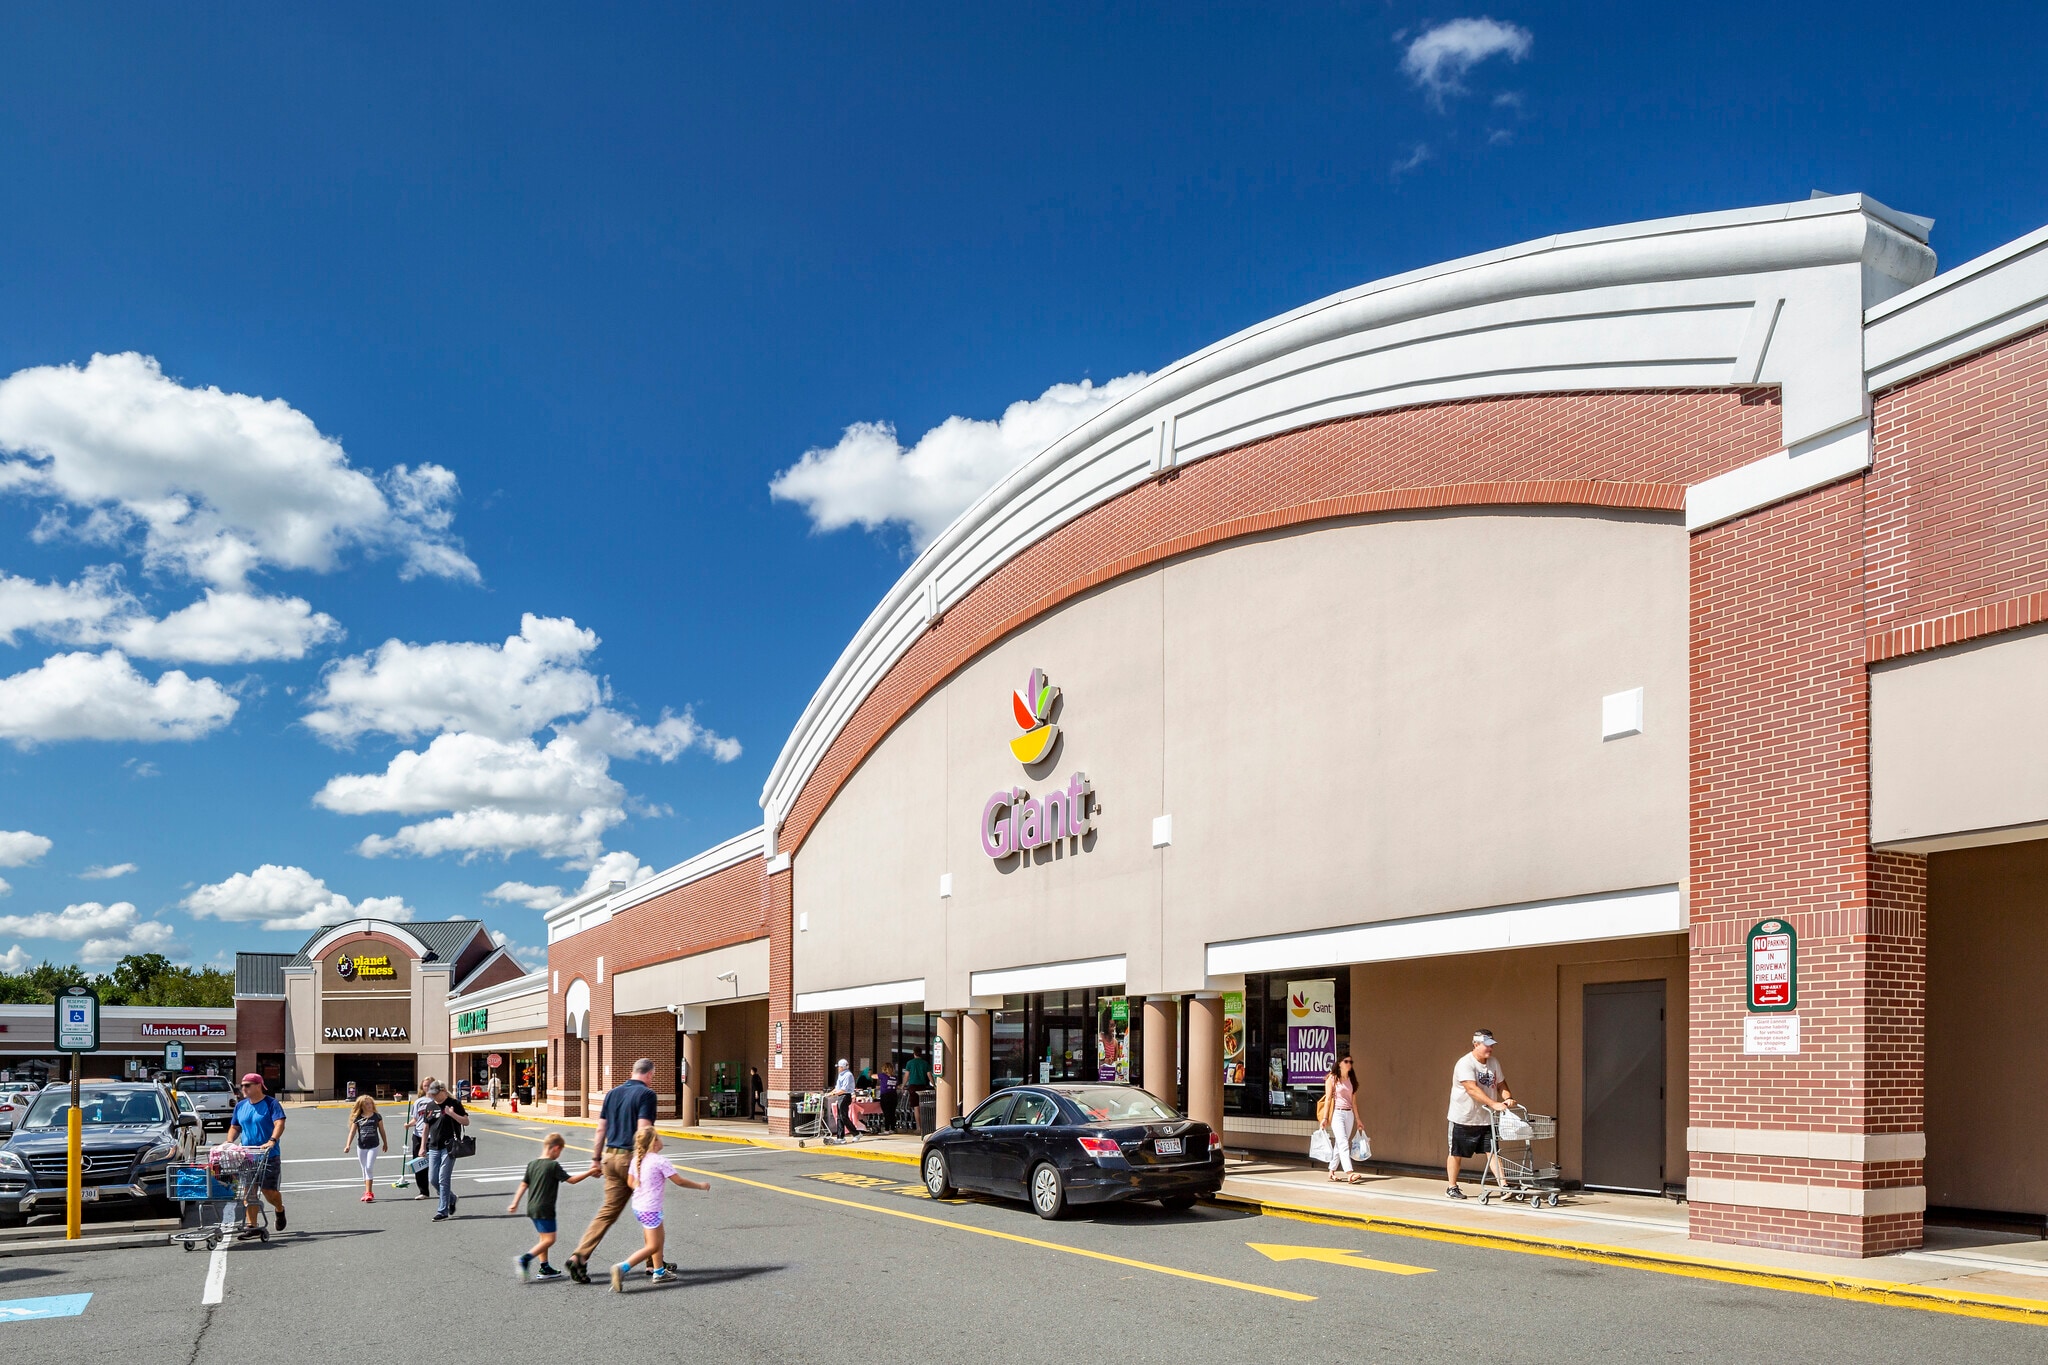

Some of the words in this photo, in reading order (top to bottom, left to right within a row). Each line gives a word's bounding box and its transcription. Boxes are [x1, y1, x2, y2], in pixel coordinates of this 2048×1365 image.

[981, 772, 1088, 859] Giant
[1755, 938, 1767, 950] NO
[1768, 939, 1787, 948] PARKING
[353, 955, 387, 968] planet
[1756, 963, 1786, 971] DRIVEWAY
[357, 965, 394, 975] fitness
[1313, 1001, 1332, 1013] Giant
[142, 1024, 197, 1036] Manhattan
[199, 1024, 225, 1036] Pizza
[324, 1027, 363, 1037] SALON
[368, 1027, 406, 1037] PLAZA
[1298, 1028, 1329, 1049] NOW
[1290, 1051, 1335, 1072] HIRING
